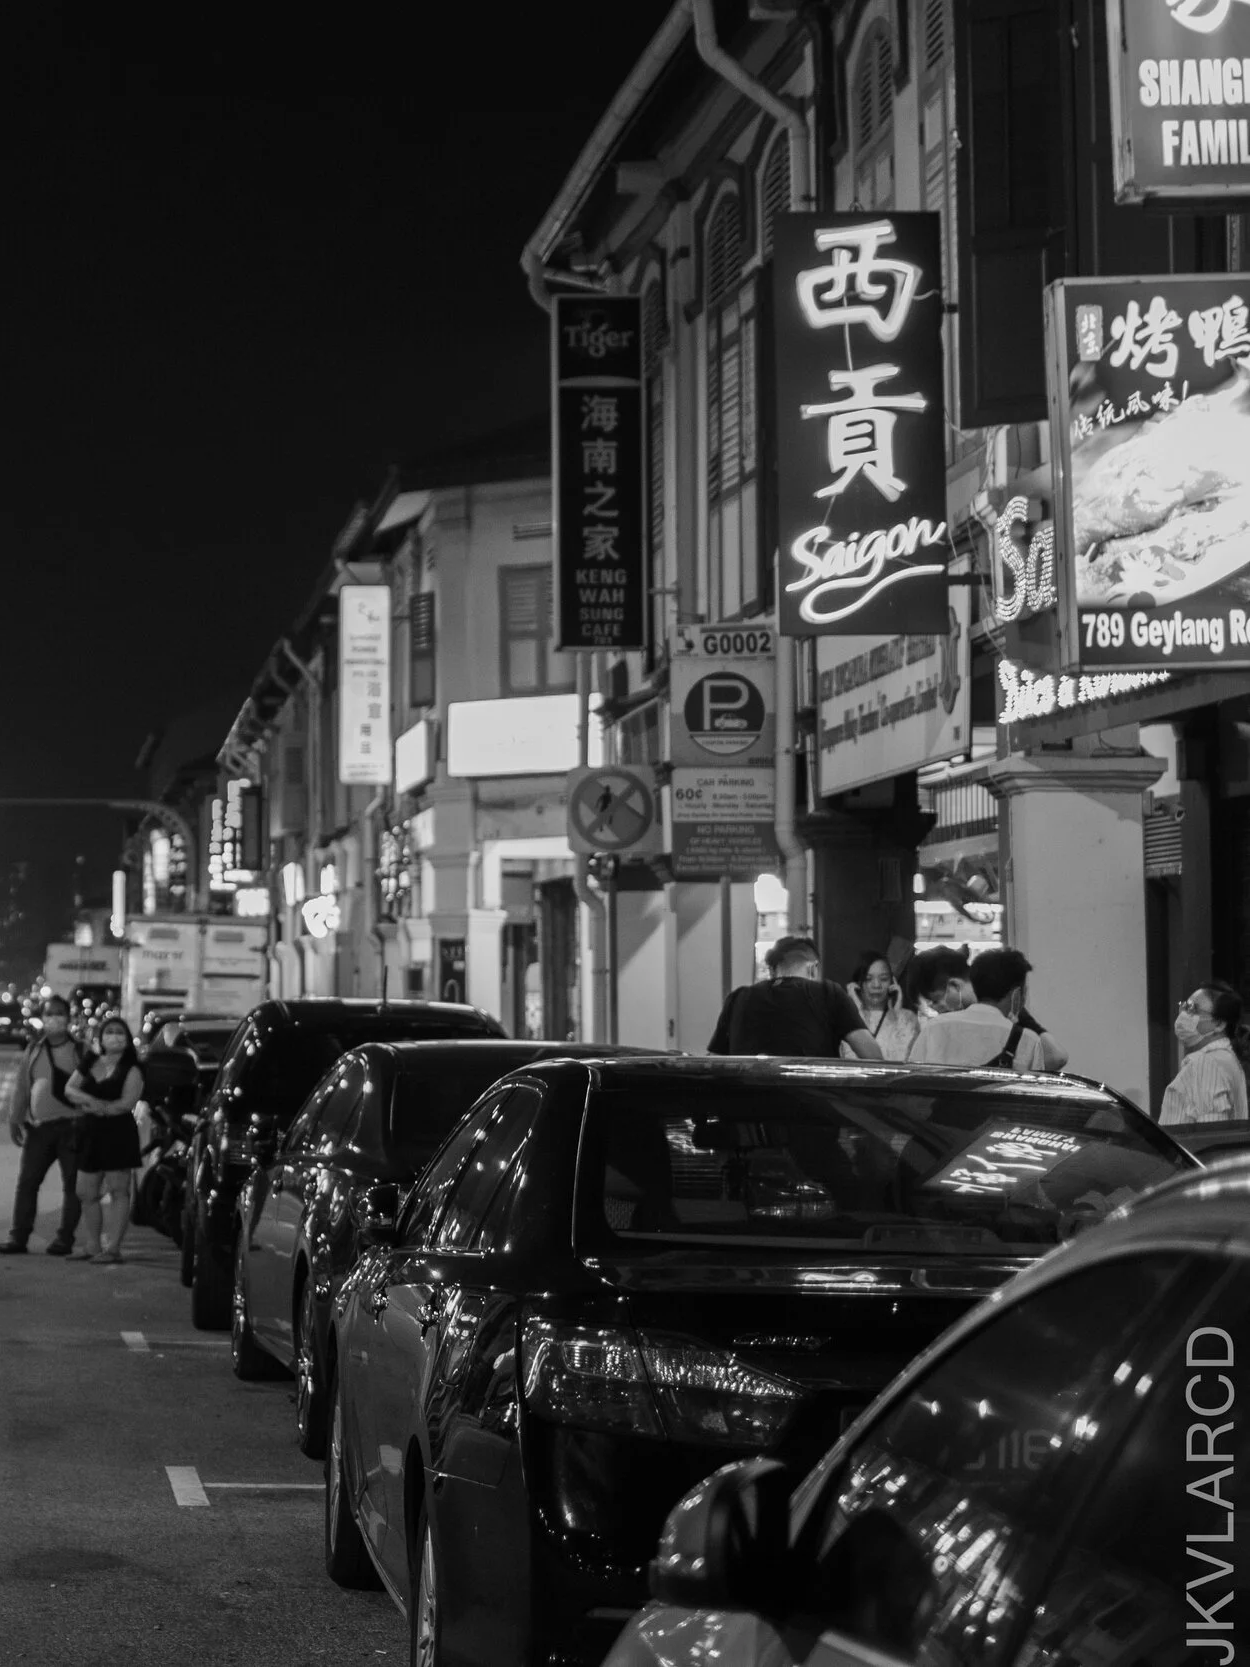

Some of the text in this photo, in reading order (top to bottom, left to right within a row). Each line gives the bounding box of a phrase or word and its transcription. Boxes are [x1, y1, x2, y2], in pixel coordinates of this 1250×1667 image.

[564, 321, 634, 358] Tiger
[796, 219, 927, 502] 西貢
[580, 394, 620, 561] 海南之家
[575, 568, 627, 585] KENG
[785, 516, 947, 624] Saigon
[578, 588, 625, 604] WAH
[579, 607, 624, 620] SUNG
[581, 623, 621, 637] CAFE
[703, 631, 771, 655] G0002
[1082, 612, 1125, 647] 789
[1130, 610, 1225, 655] Geylang
[703, 679, 749, 731] P
[696, 778, 755, 787] CAR PARKING
